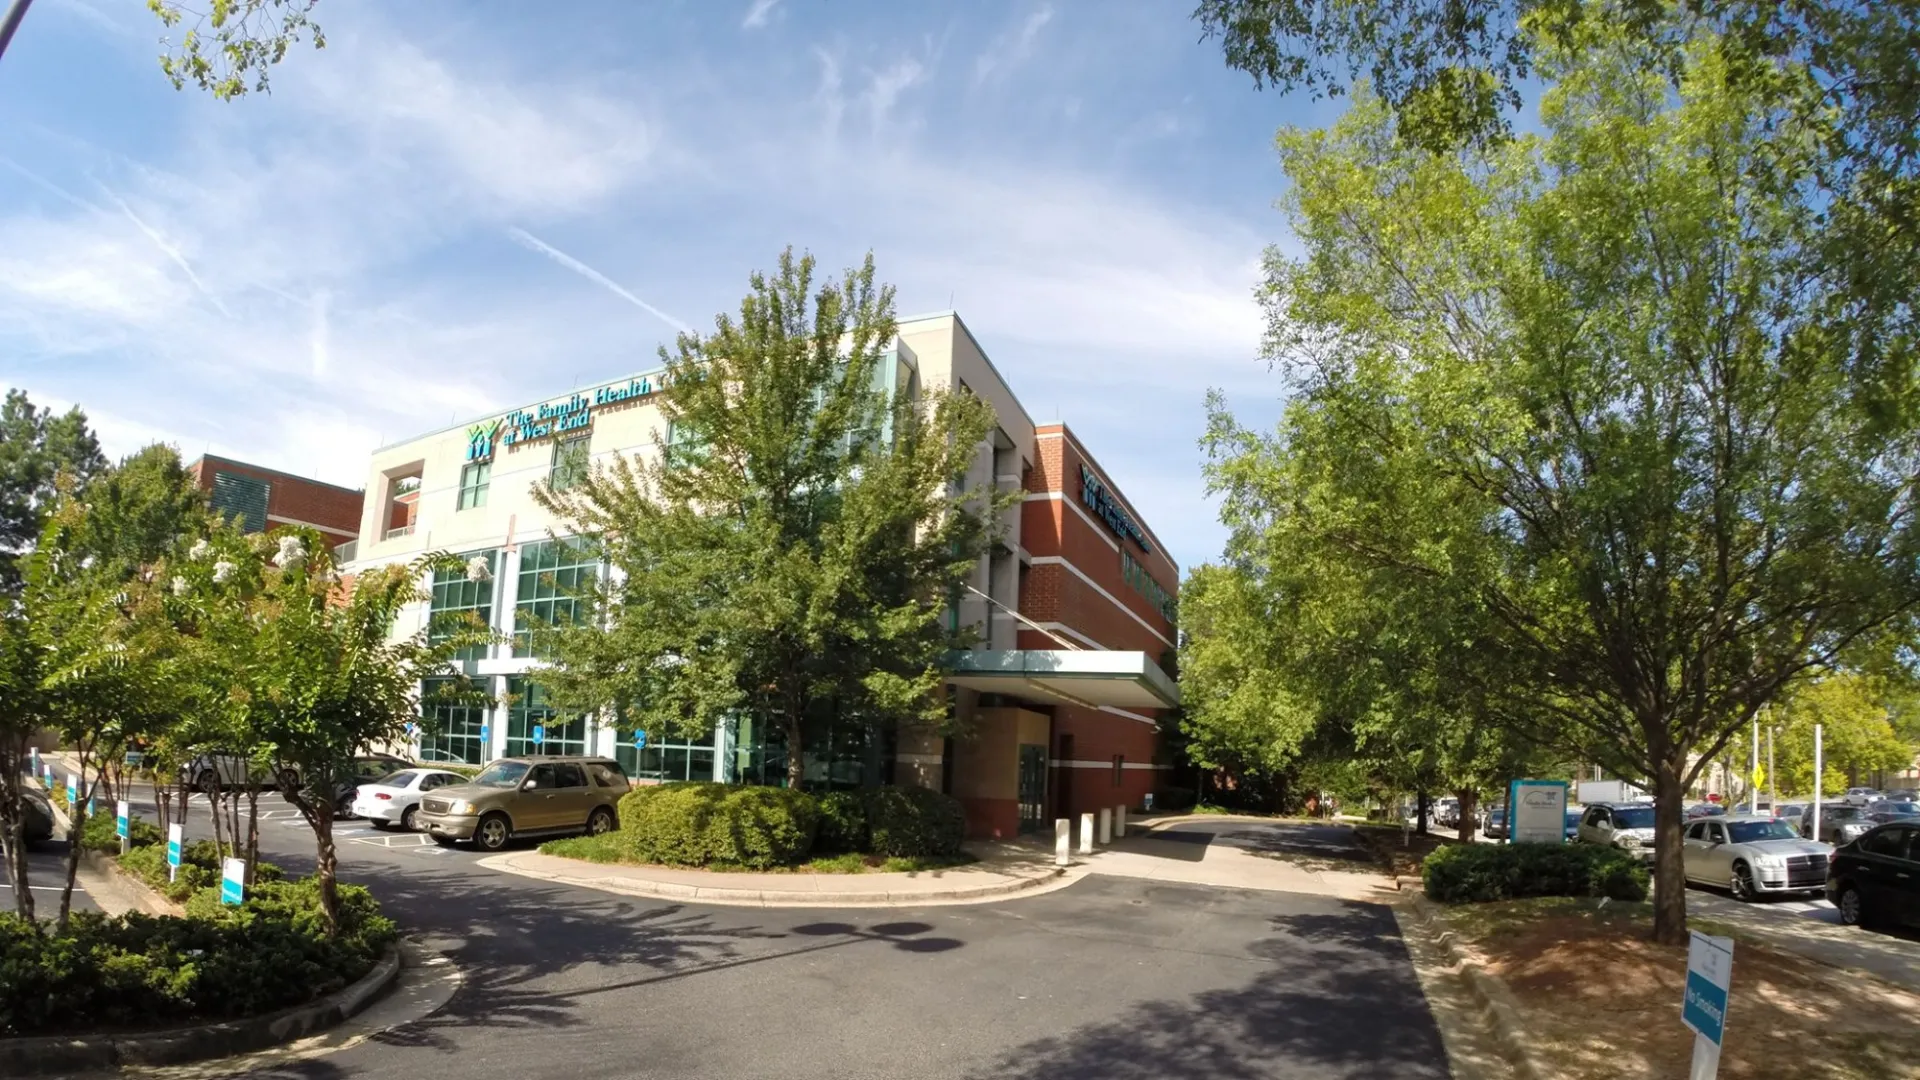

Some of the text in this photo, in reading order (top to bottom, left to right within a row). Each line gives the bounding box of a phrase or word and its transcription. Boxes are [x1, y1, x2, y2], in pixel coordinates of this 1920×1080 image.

[507, 409, 533, 429] The
[537, 394, 589, 421] Family
[594, 376, 651, 405] Health
[503, 408, 590, 447] at West End
[1696, 991, 1722, 1027] Smoking
